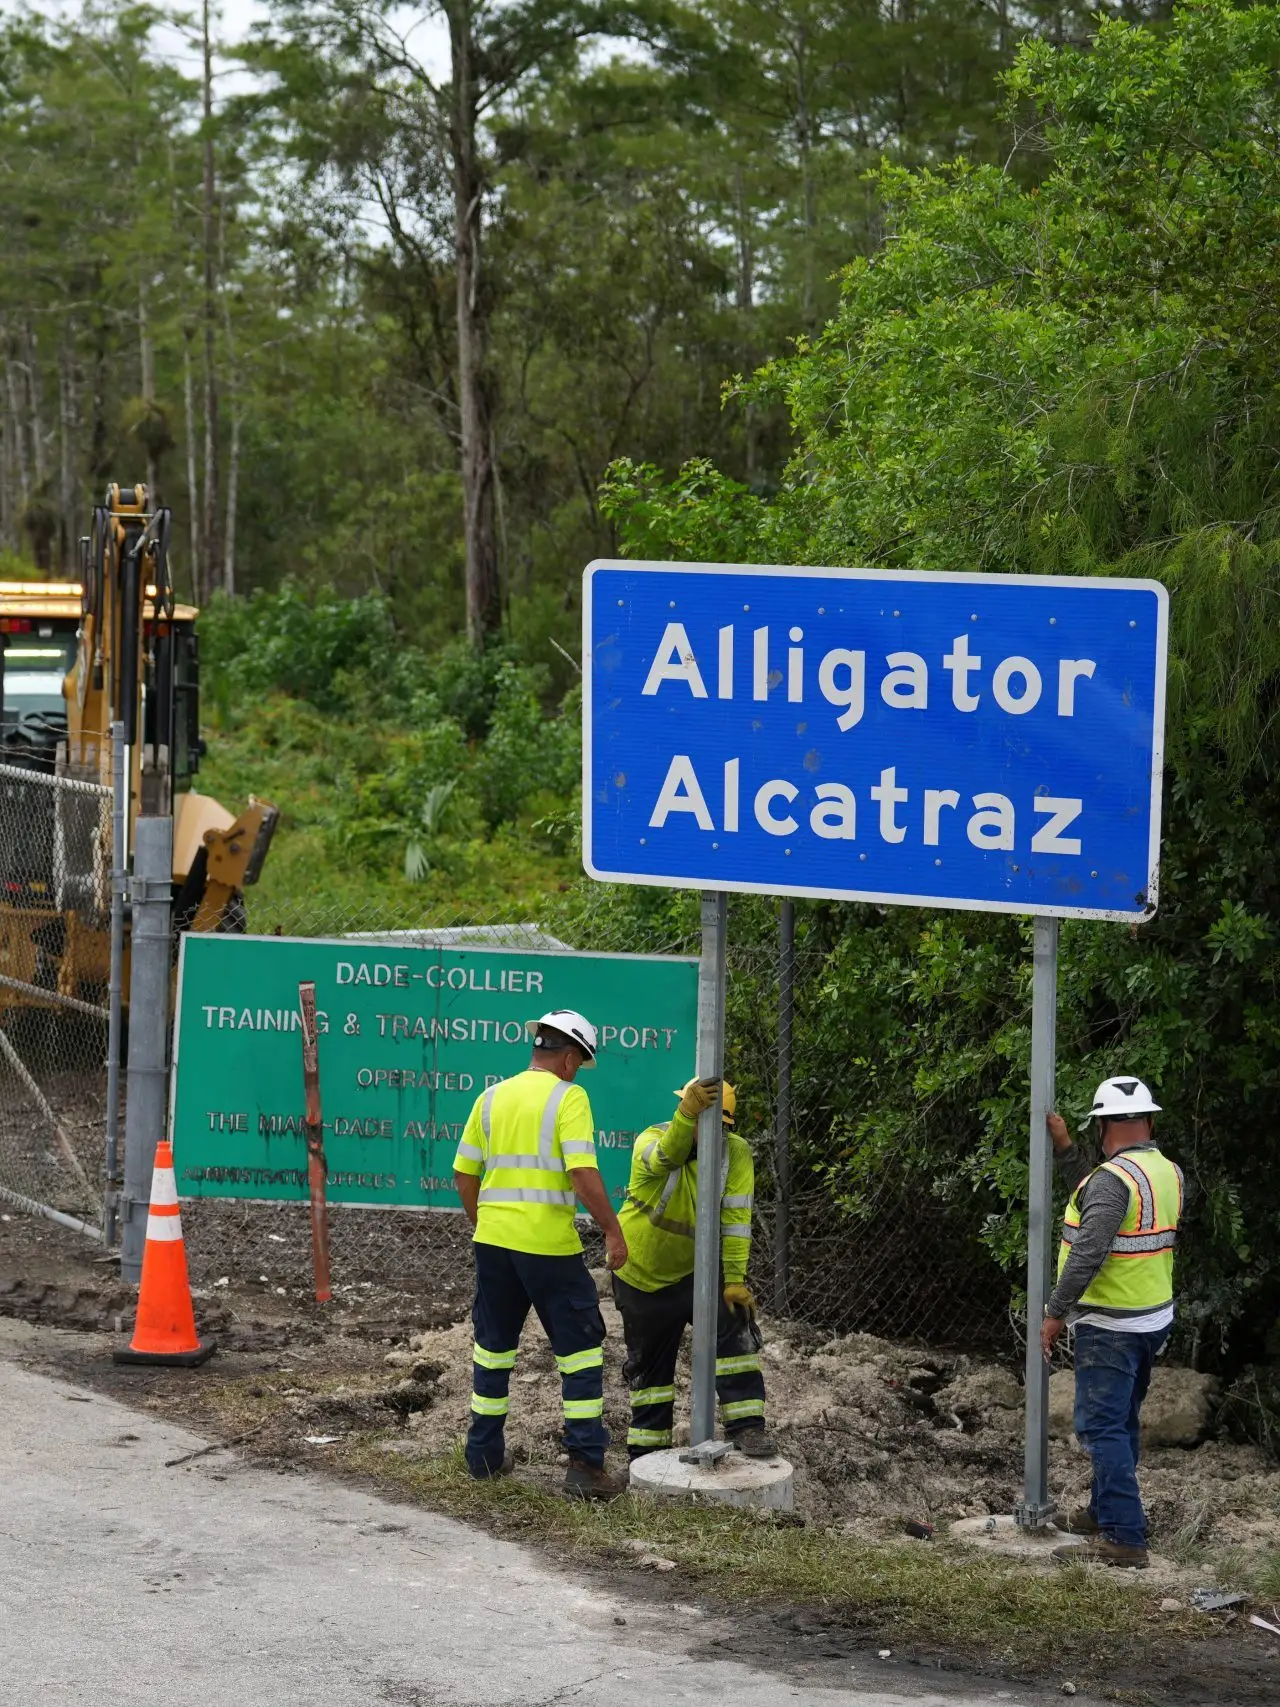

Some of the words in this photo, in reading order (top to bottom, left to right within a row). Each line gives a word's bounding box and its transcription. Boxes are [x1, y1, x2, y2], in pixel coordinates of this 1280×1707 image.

[641, 622, 1097, 732] Alligator
[648, 755, 1083, 855] Alcatraz
[336, 962, 544, 994] DADE-COLLIER
[201, 1006, 329, 1033] TRAINING
[343, 1012, 360, 1035] &
[593, 1025, 678, 1050] PORT
[357, 1067, 474, 1091] OPERATED
[207, 1111, 248, 1132] THE
[259, 1114, 393, 1139] MIA-DADE
[402, 1119, 464, 1140] AVIAT
[181, 1165, 310, 1187] ADMINISTRATIV
[324, 1171, 396, 1189] OFFICES
[420, 1176, 459, 1191] MIA
